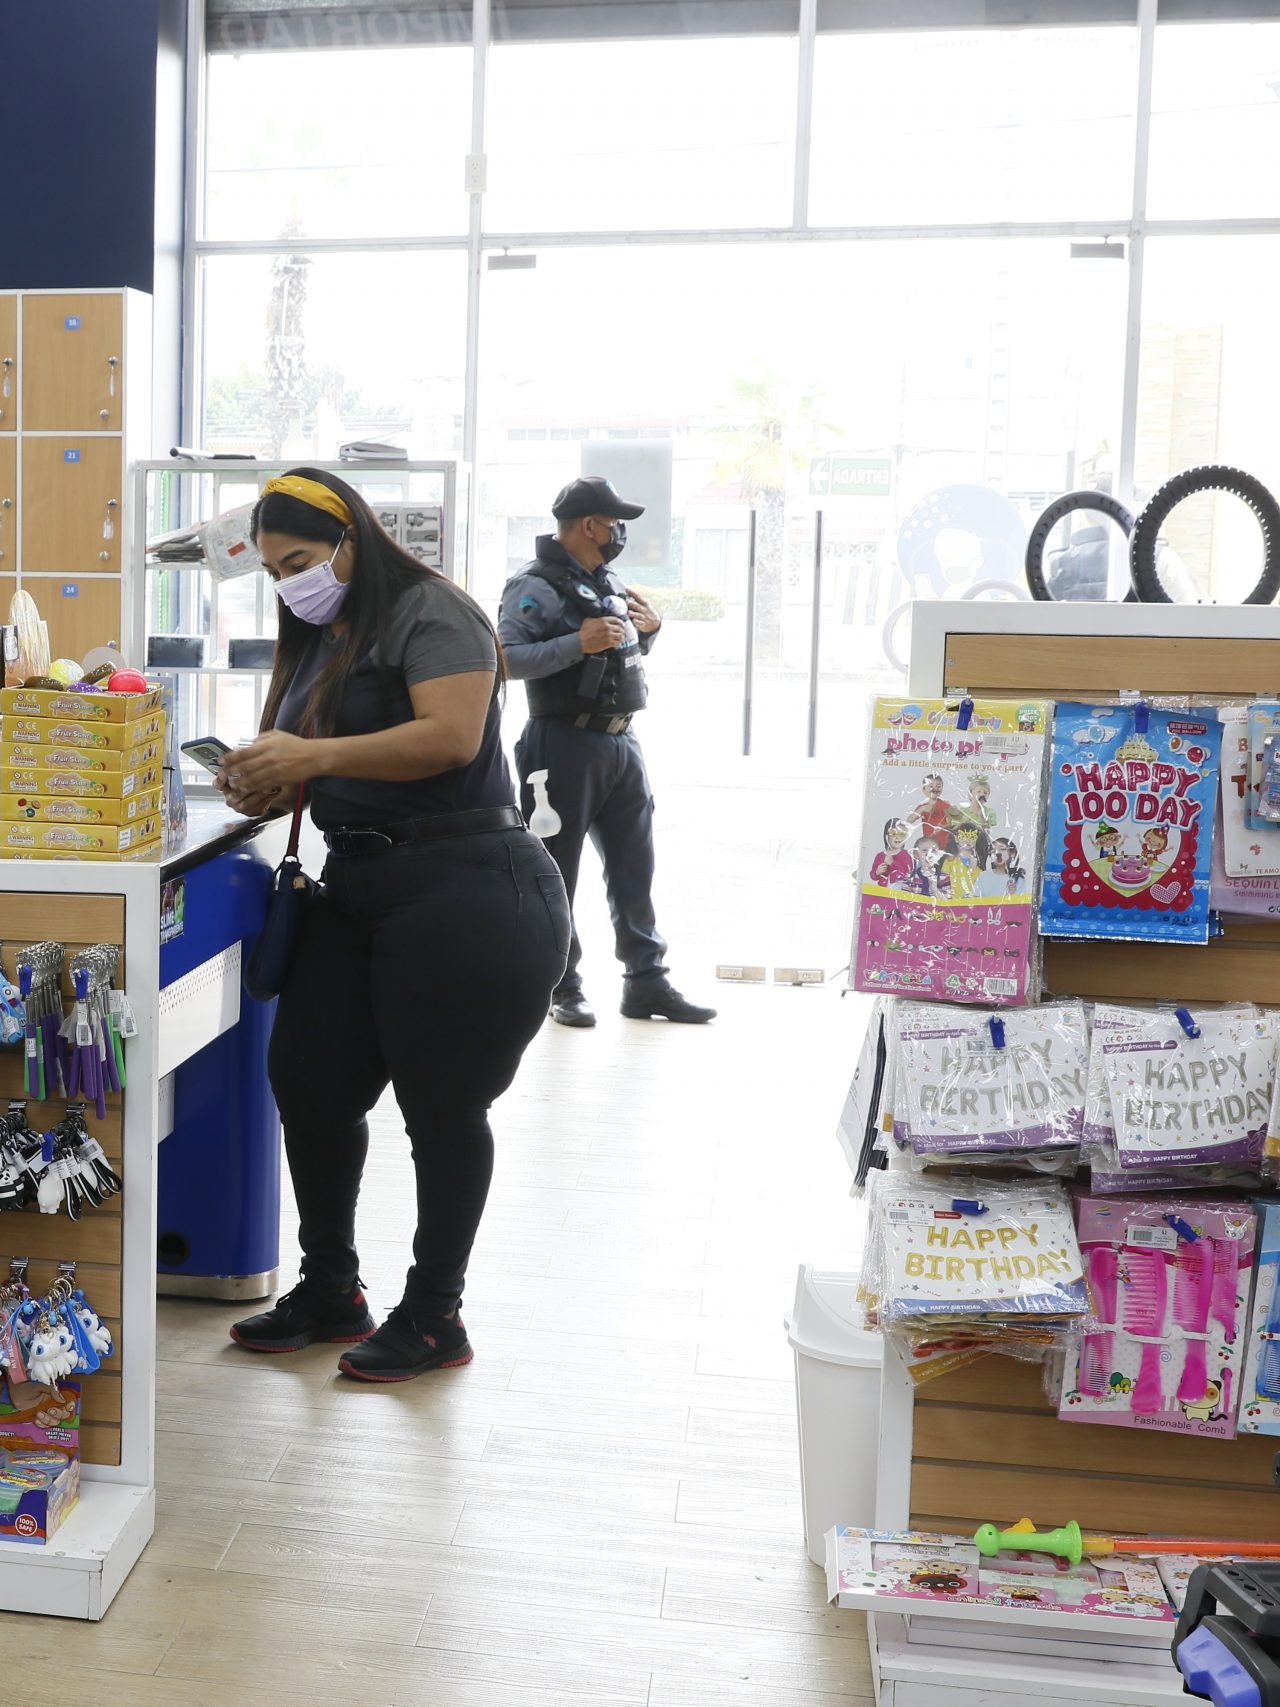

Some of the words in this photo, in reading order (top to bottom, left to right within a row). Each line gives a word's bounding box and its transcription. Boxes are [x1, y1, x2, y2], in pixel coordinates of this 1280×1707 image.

[887, 732, 954, 758] photo
[882, 758, 899, 767] Add
[908, 759, 930, 768] little
[932, 762, 969, 771] surprise
[970, 762, 980, 770] to
[1075, 761, 1201, 798] HAPPY
[1064, 791, 1128, 822] 100
[1135, 793, 1202, 827] DAY
[941, 1038, 1053, 1077] HAPPY
[1144, 1052, 1248, 1091] HAPPY
[920, 1067, 1086, 1116] BIRTHDAY
[1124, 1081, 1273, 1131] BIRTHDAY
[1172, 1153, 1198, 1161] BIRTHDAY
[926, 1223, 1039, 1250] HAPPY
[904, 1248, 1072, 1281] BIRTHDAY
[1133, 1415, 1192, 1430] Fashionable
[1197, 1423, 1227, 1435] Comb
[18, 1524, 33, 1532] SAFE
[19, 1518, 34, 1526] 100%
